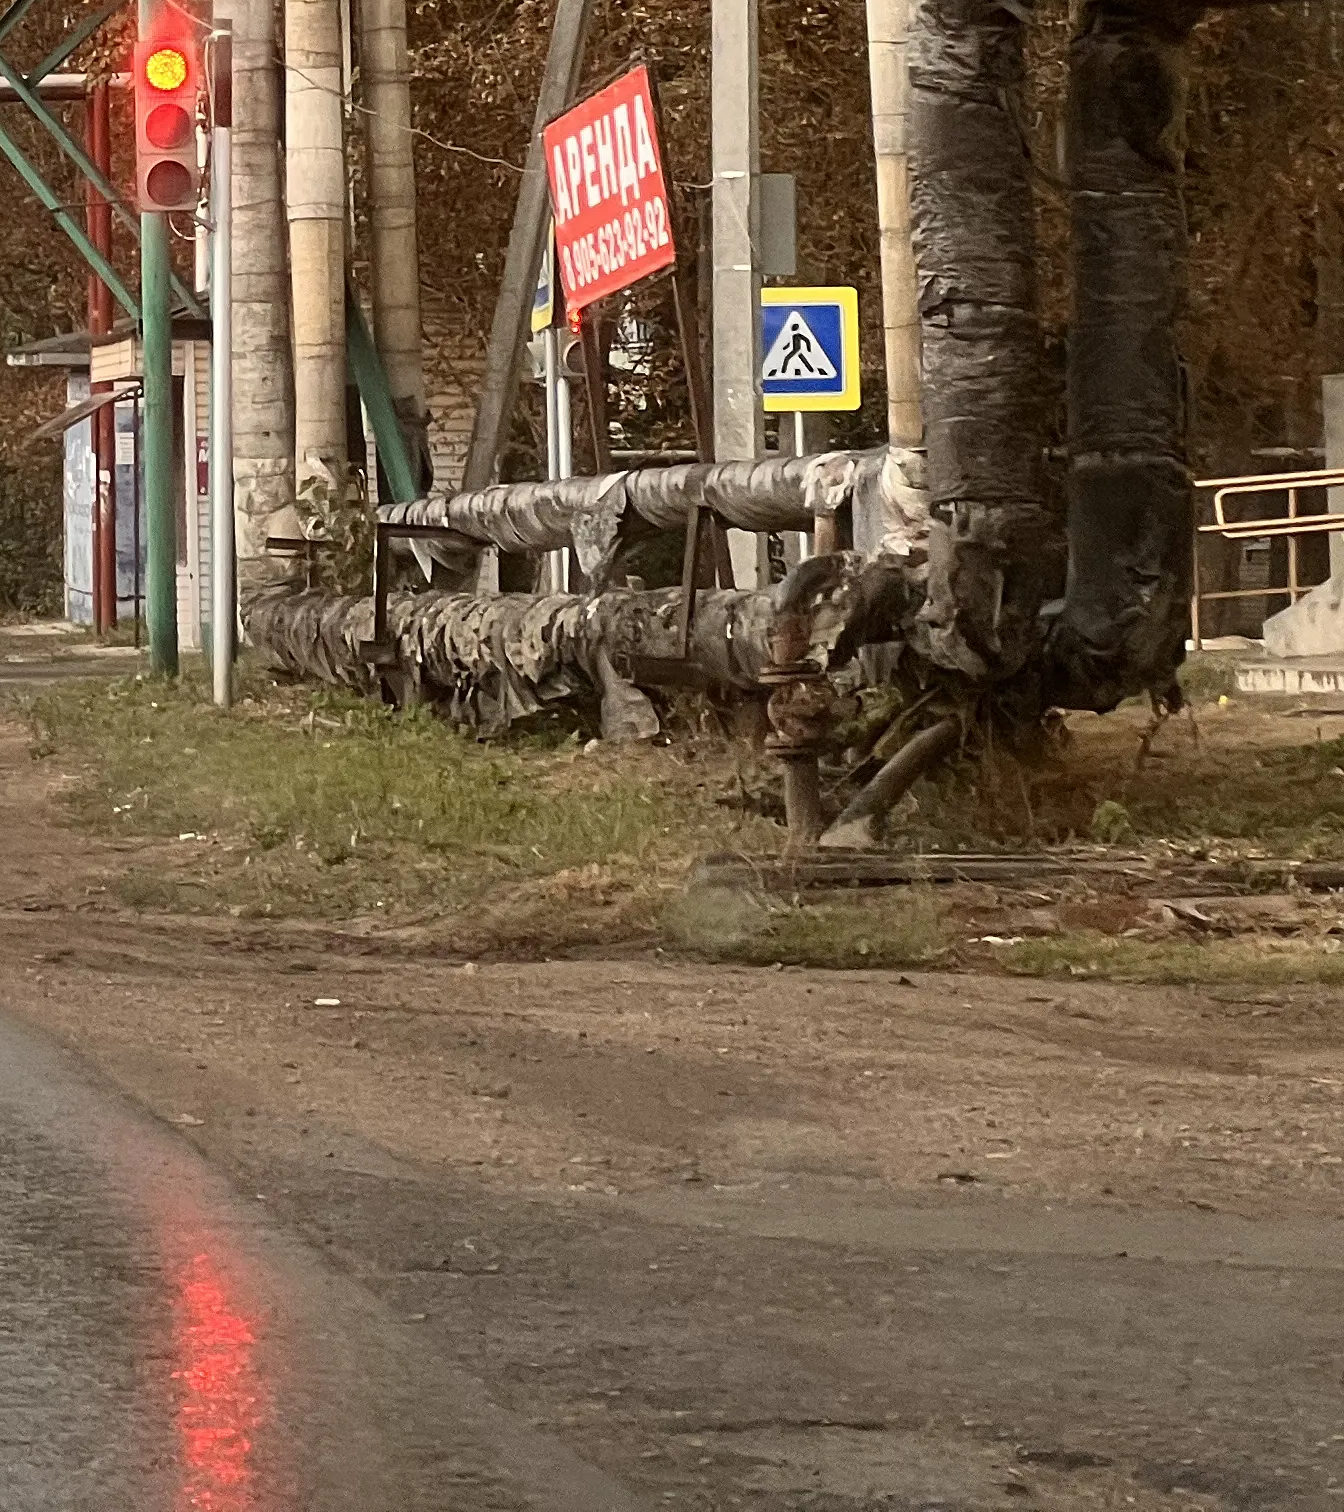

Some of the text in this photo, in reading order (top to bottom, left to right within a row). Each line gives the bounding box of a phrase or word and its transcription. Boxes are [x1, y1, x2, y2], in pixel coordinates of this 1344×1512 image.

[554, 94, 657, 224] АРЕНДА
[563, 196, 669, 291] 8 905-623-92-92
